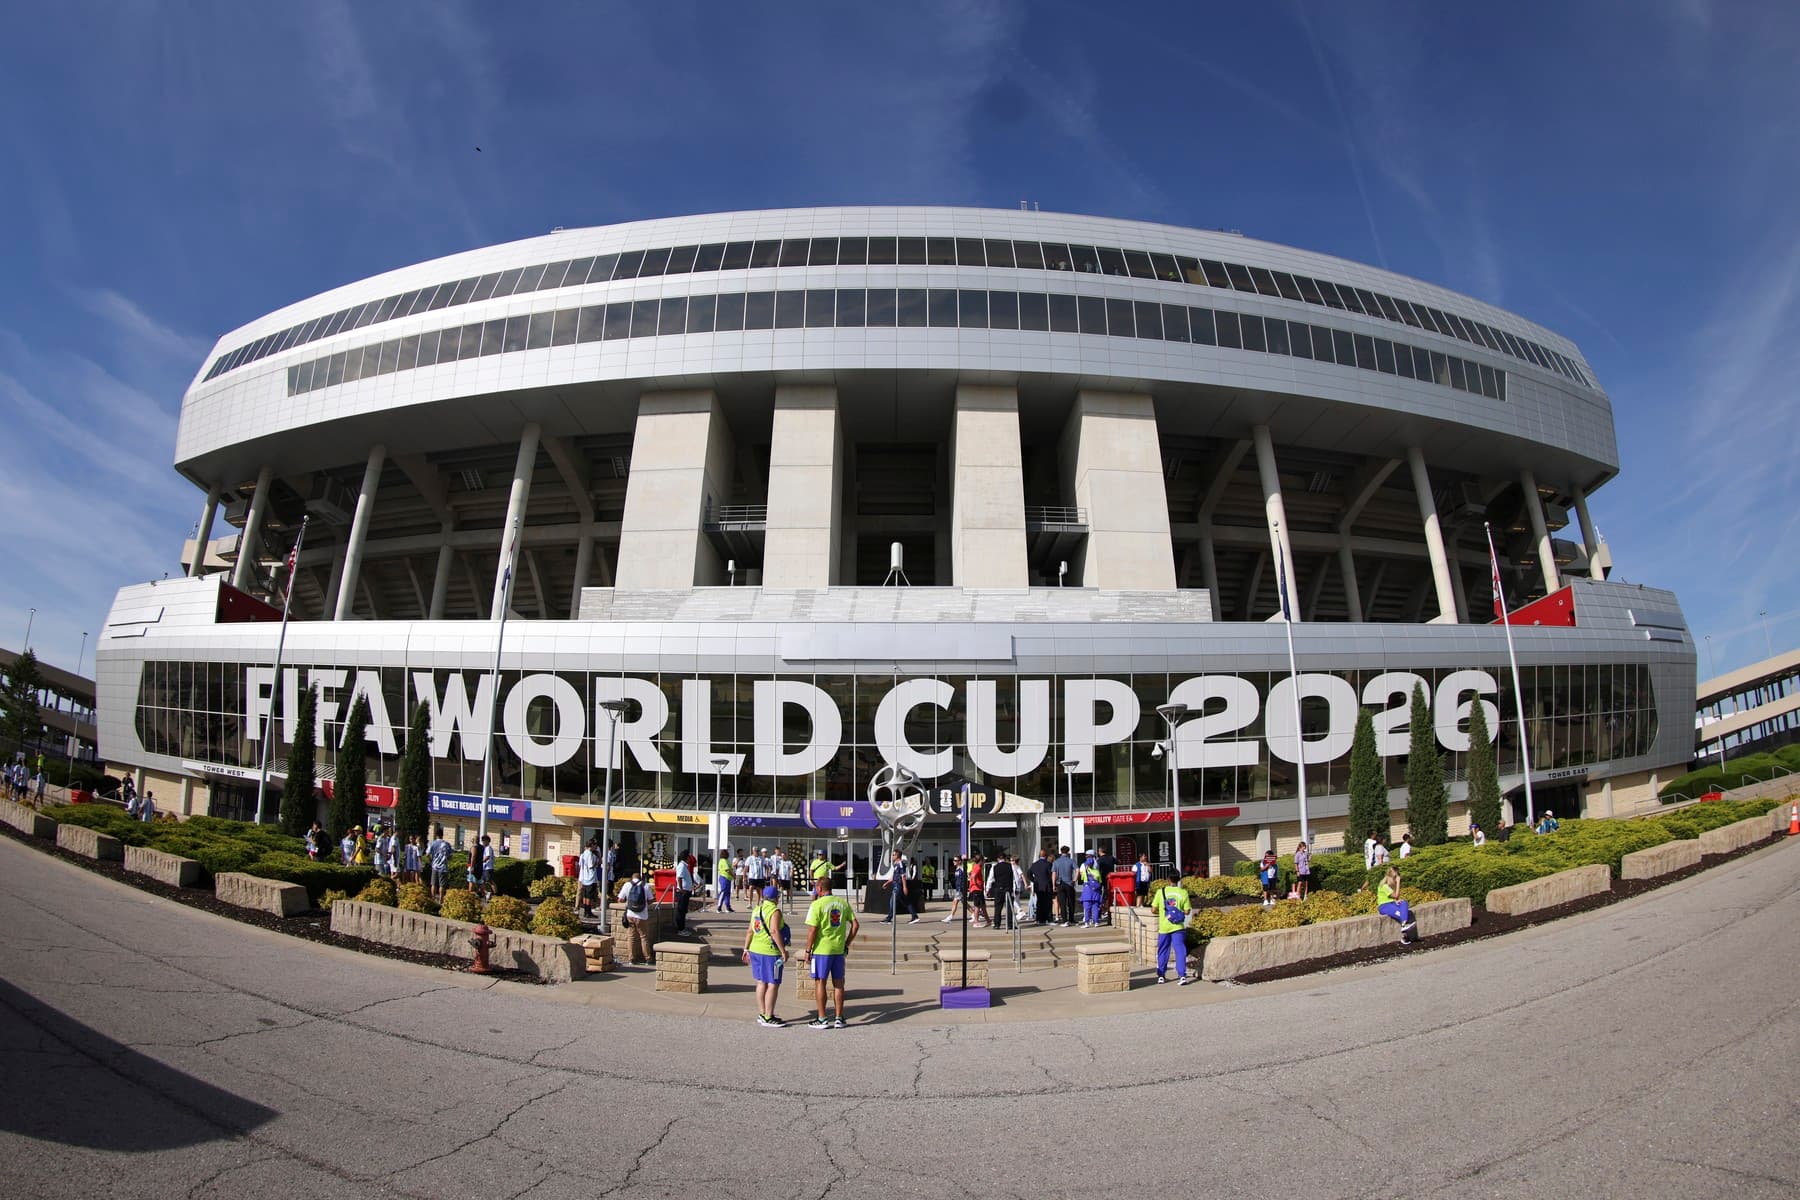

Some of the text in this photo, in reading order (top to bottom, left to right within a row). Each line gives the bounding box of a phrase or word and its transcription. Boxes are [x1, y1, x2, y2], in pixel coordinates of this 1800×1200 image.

[246, 667, 1499, 779] FIFA WORLD CUP 2026
[203, 765, 225, 773] TOWER
[1548, 767, 1589, 779] TOWER EAST
[441, 799, 509, 815] TICKET RESOLUTN POINT
[839, 806, 854, 817] VIP
[676, 815, 693, 823] MEDIA
[1084, 815, 1111, 825] SPITALITY
